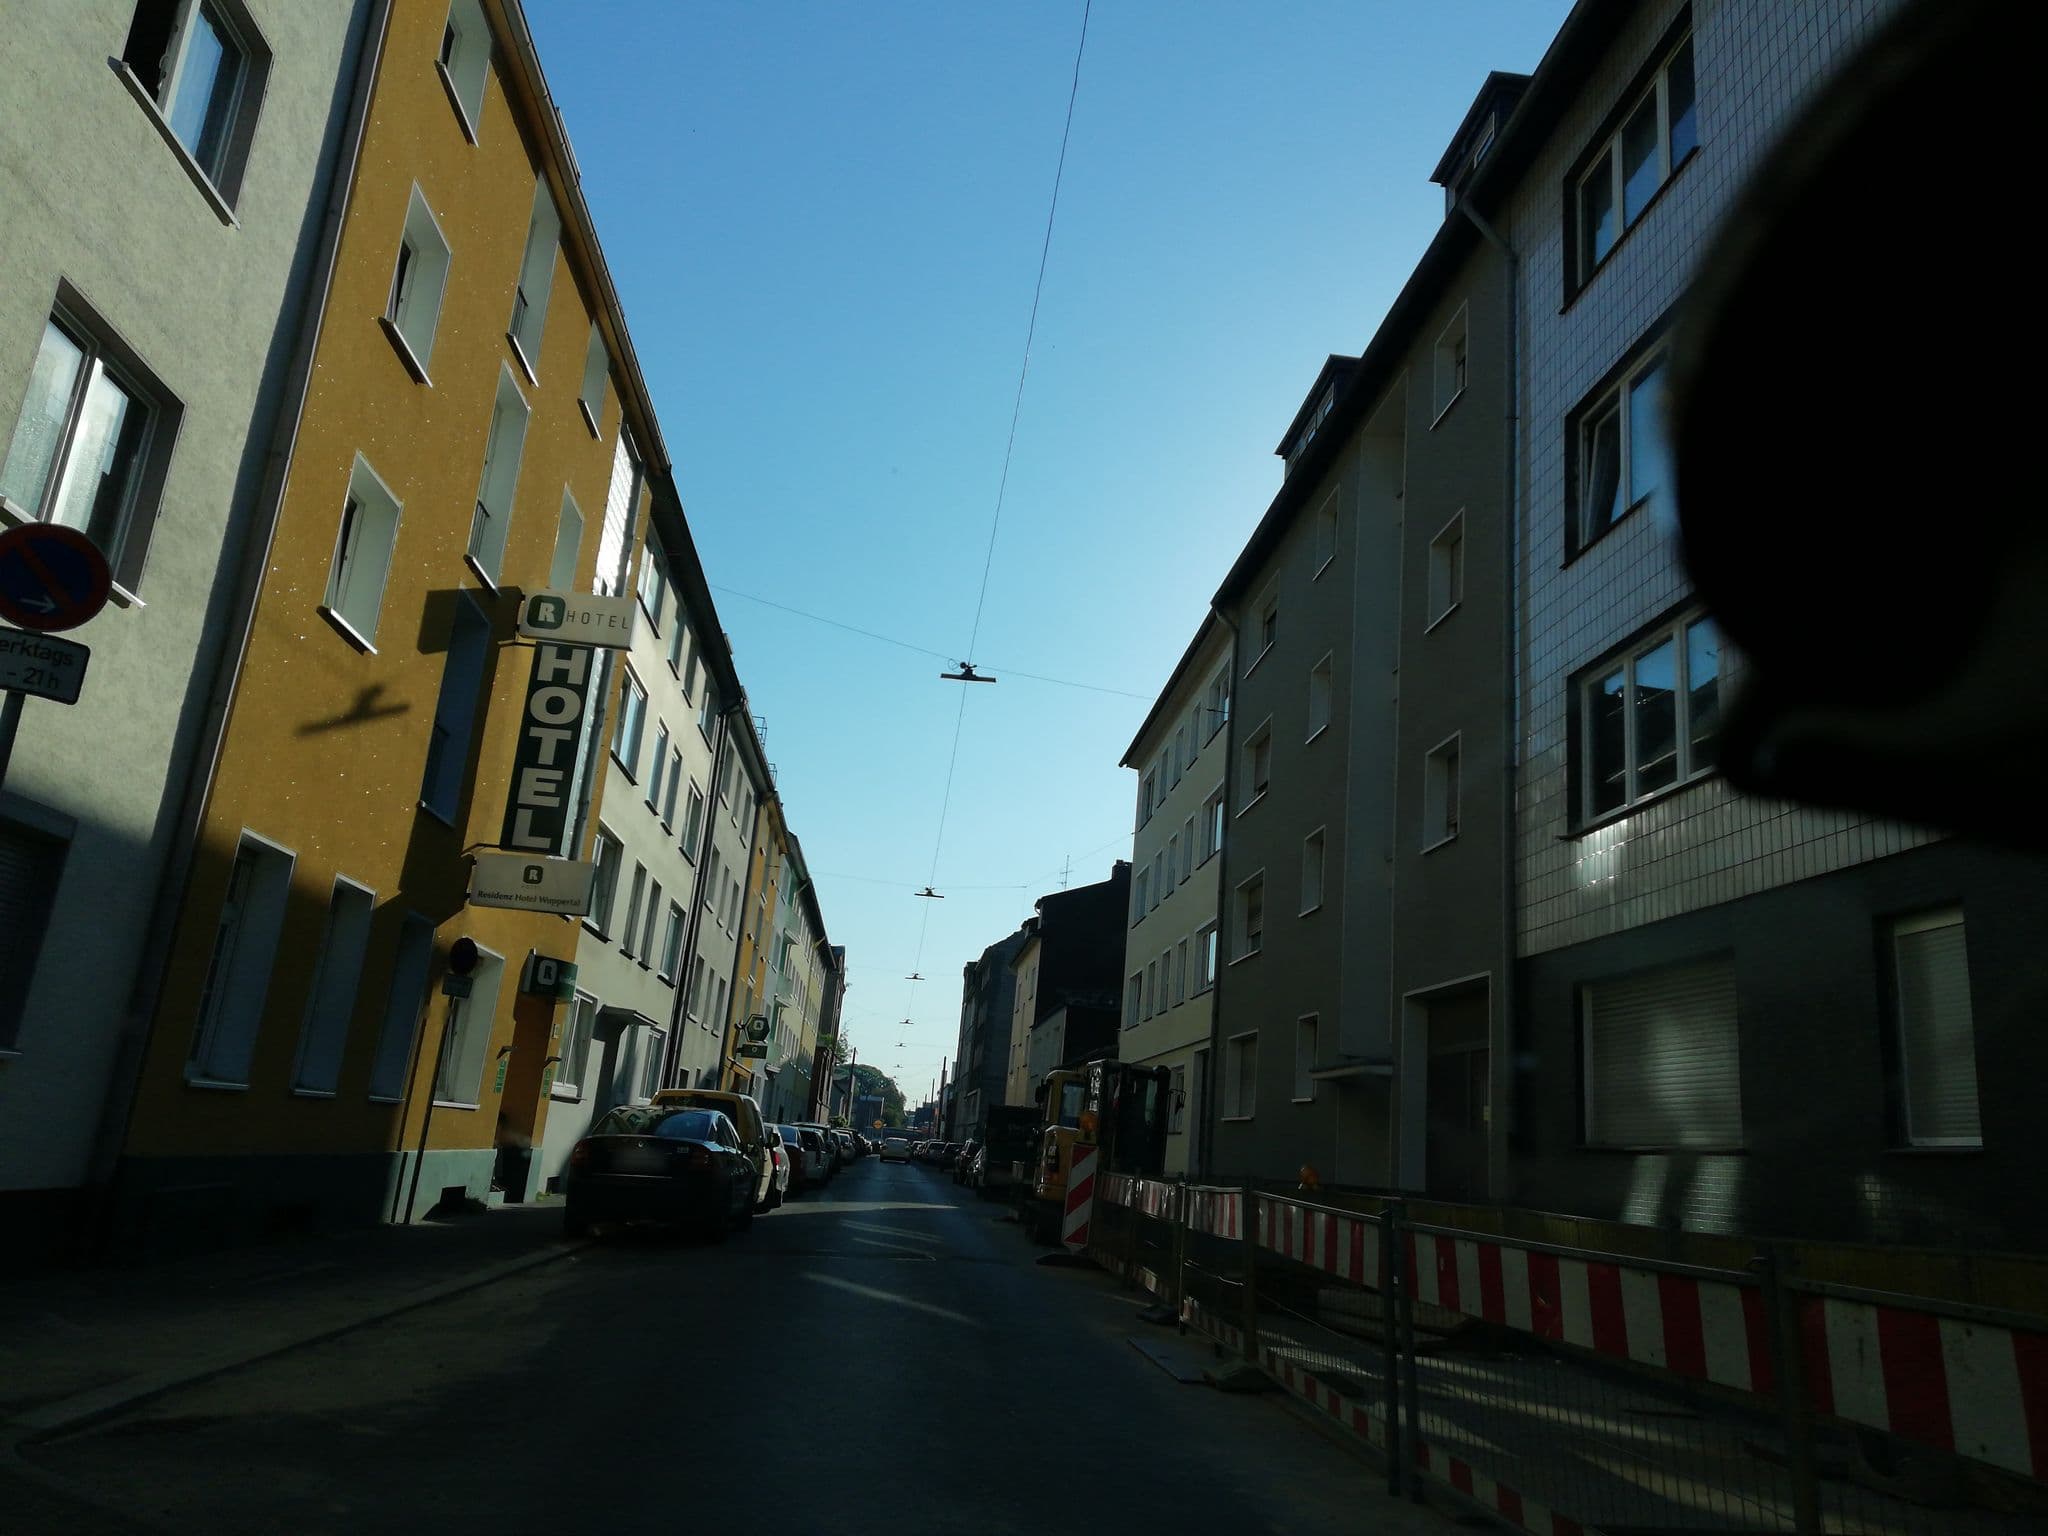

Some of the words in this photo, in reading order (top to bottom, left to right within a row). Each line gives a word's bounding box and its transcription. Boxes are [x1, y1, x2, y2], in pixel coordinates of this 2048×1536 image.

[537, 602, 555, 623] R
[566, 610, 629, 629] HOTEL
[0, 638, 74, 666] erktags
[512, 645, 588, 849] HOTEL
[478, 889, 514, 901] Residenz
[515, 893, 538, 903] Hotel
[539, 894, 580, 908] Wuppertal
